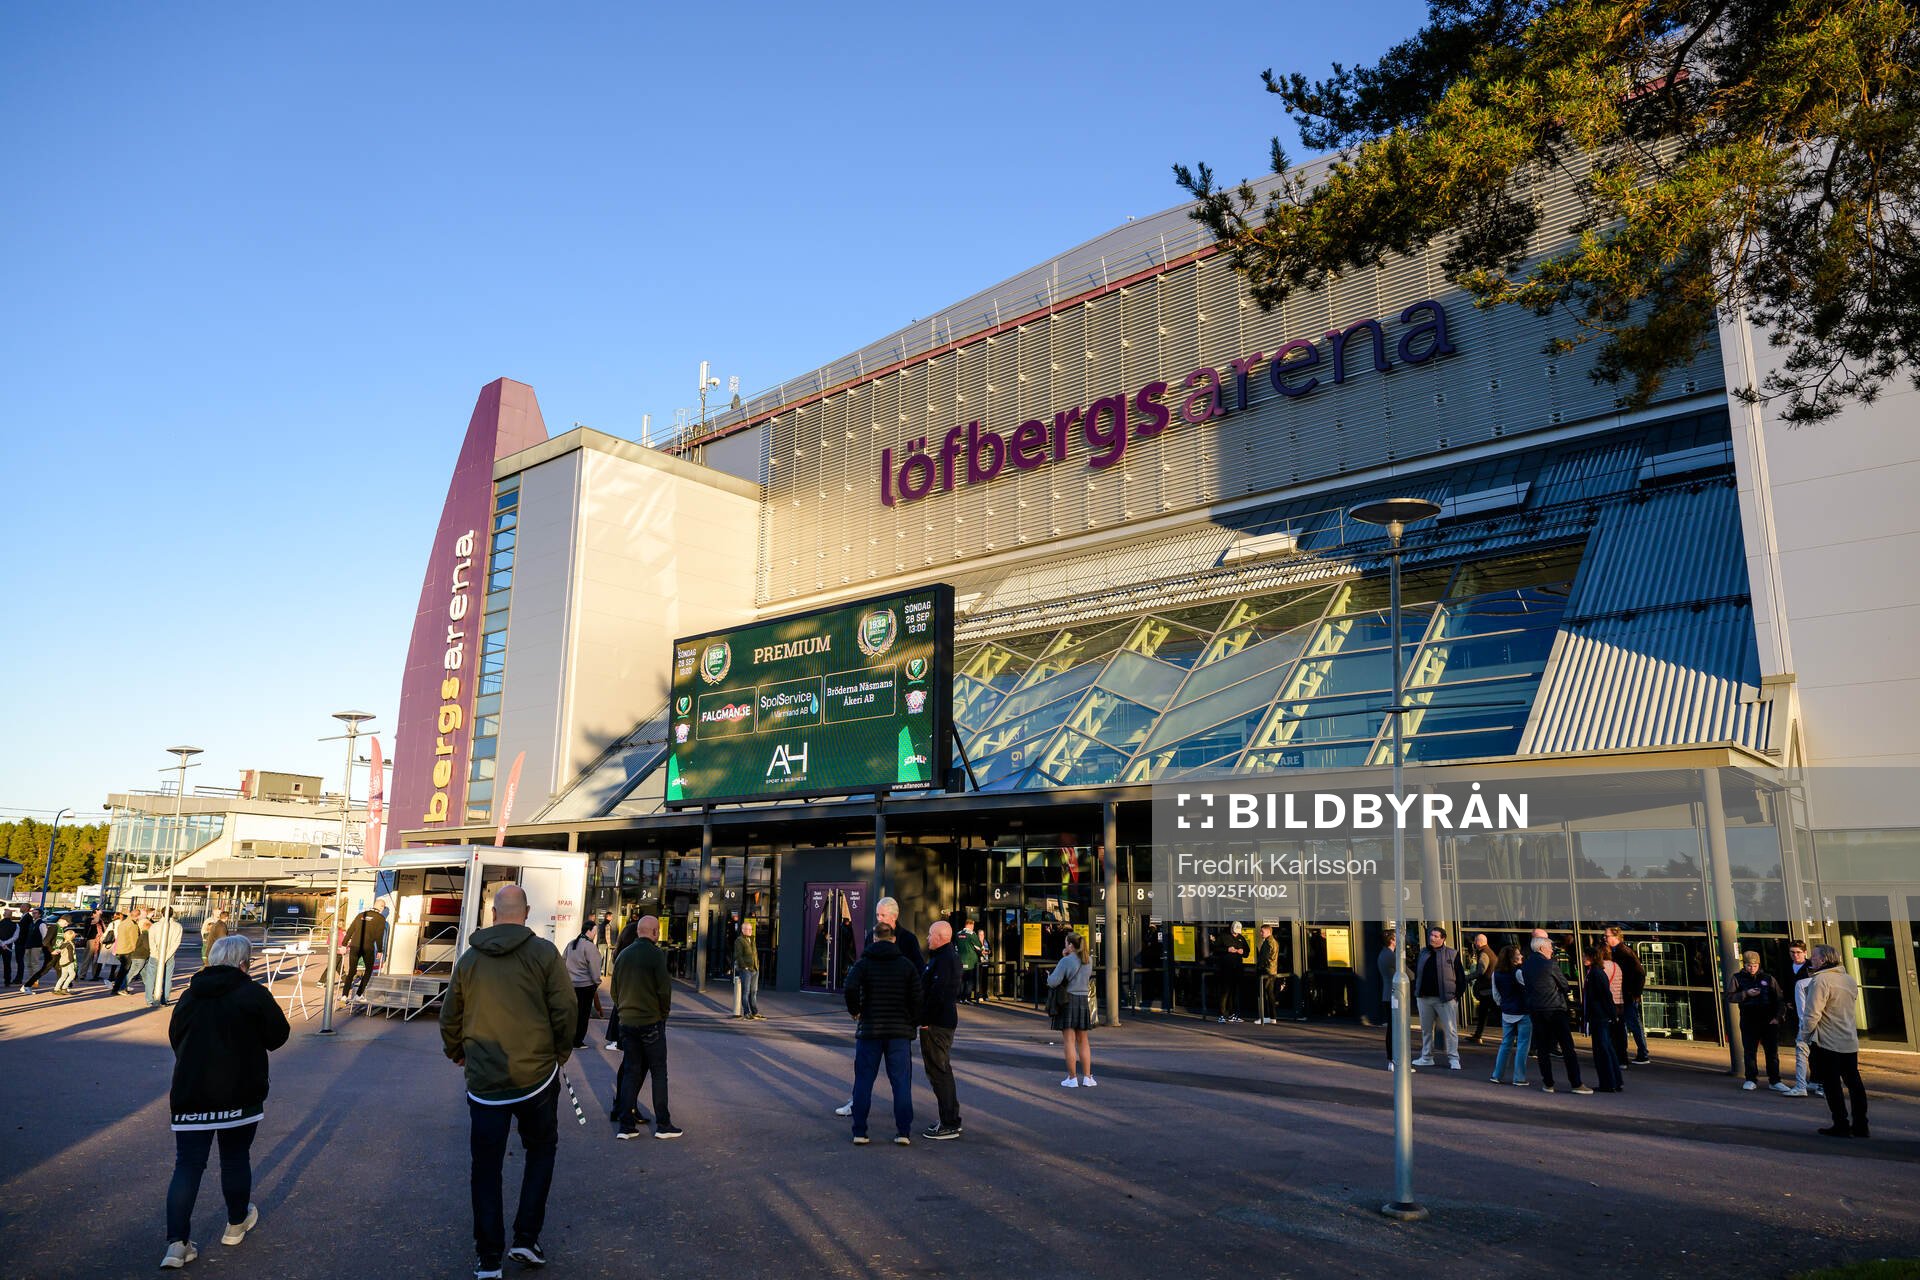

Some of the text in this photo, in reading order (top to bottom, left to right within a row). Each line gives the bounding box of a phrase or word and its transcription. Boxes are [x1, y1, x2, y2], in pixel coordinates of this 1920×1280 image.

[905, 611, 930, 624] 28 SEP
[908, 623, 926, 634] 13:00
[753, 635, 832, 666] PREMIUM
[826, 680, 893, 697] Bröderna Näsmans
[760, 691, 812, 711] SpolService
[843, 693, 875, 707] Åkeri AB
[702, 705, 751, 722] FALGMAN.SE
[799, 706, 809, 715] AB
[994, 888, 1001, 900] 6
[1099, 888, 1106, 900] 7
[1137, 888, 1145, 900] 8
